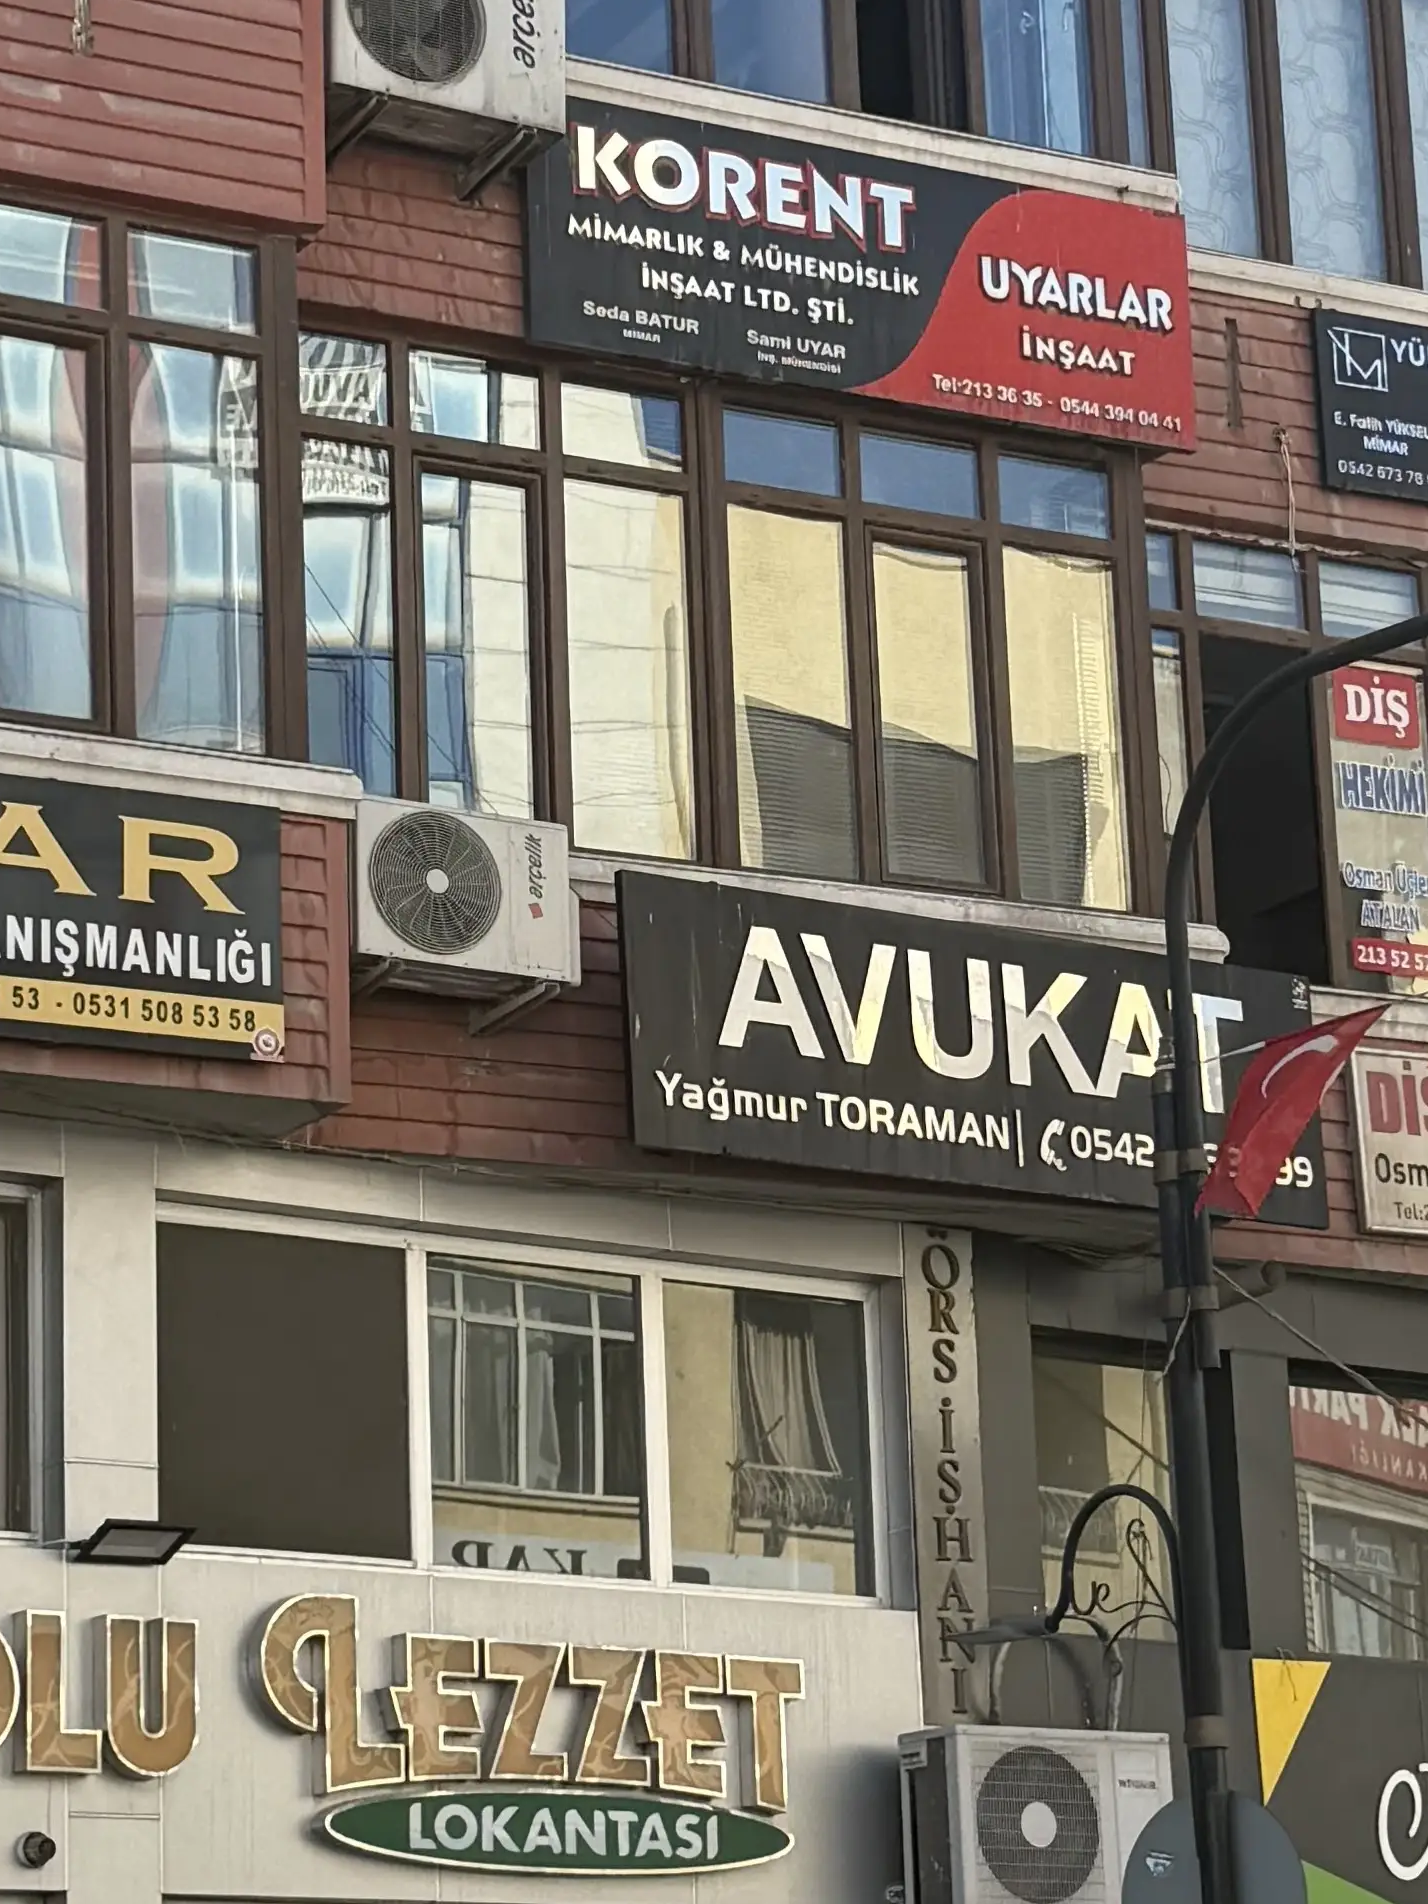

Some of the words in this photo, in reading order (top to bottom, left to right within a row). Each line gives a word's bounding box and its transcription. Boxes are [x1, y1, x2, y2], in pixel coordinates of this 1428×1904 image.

[573, 124, 913, 249] KORENT
[567, 213, 705, 258] MİMARLIK
[712, 240, 730, 261] &
[741, 244, 920, 297] MÜHENDİSLİK
[583, 300, 630, 323] Seda
[635, 309, 700, 335] BATUR
[641, 261, 735, 303] İNŞAAT
[744, 284, 800, 315] LTD.
[807, 297, 854, 325] ŞTİ.
[980, 255, 1173, 331] UYARLAR
[746, 329, 791, 351] Sami
[796, 337, 846, 360] UYAR
[1022, 325, 1135, 376] İNŞAAT
[1060, 397, 1099, 418] 0544
[1343, 676, 1410, 739] DİŞ
[1335, 753, 1428, 817] HEKİMİ
[524, 833, 548, 900] arçelik
[1341, 861, 1393, 892] Osman
[1360, 899, 1420, 933] ATALAN
[1357, 945, 1386, 966] 213
[1391, 949, 1410, 969] 52
[11, 984, 40, 1011] 53
[140, 998, 183, 1025] 508
[192, 1002, 220, 1028] 53
[229, 1007, 256, 1033] 58
[718, 925, 1243, 1115] AVUKAT
[654, 1068, 808, 1126] Yağmur
[816, 1091, 1010, 1152] TORAMAN
[1070, 1125, 1155, 1168] 0542
[257, 1592, 807, 1813] LEZZET
[406, 1797, 721, 1863] LOKANTASI
